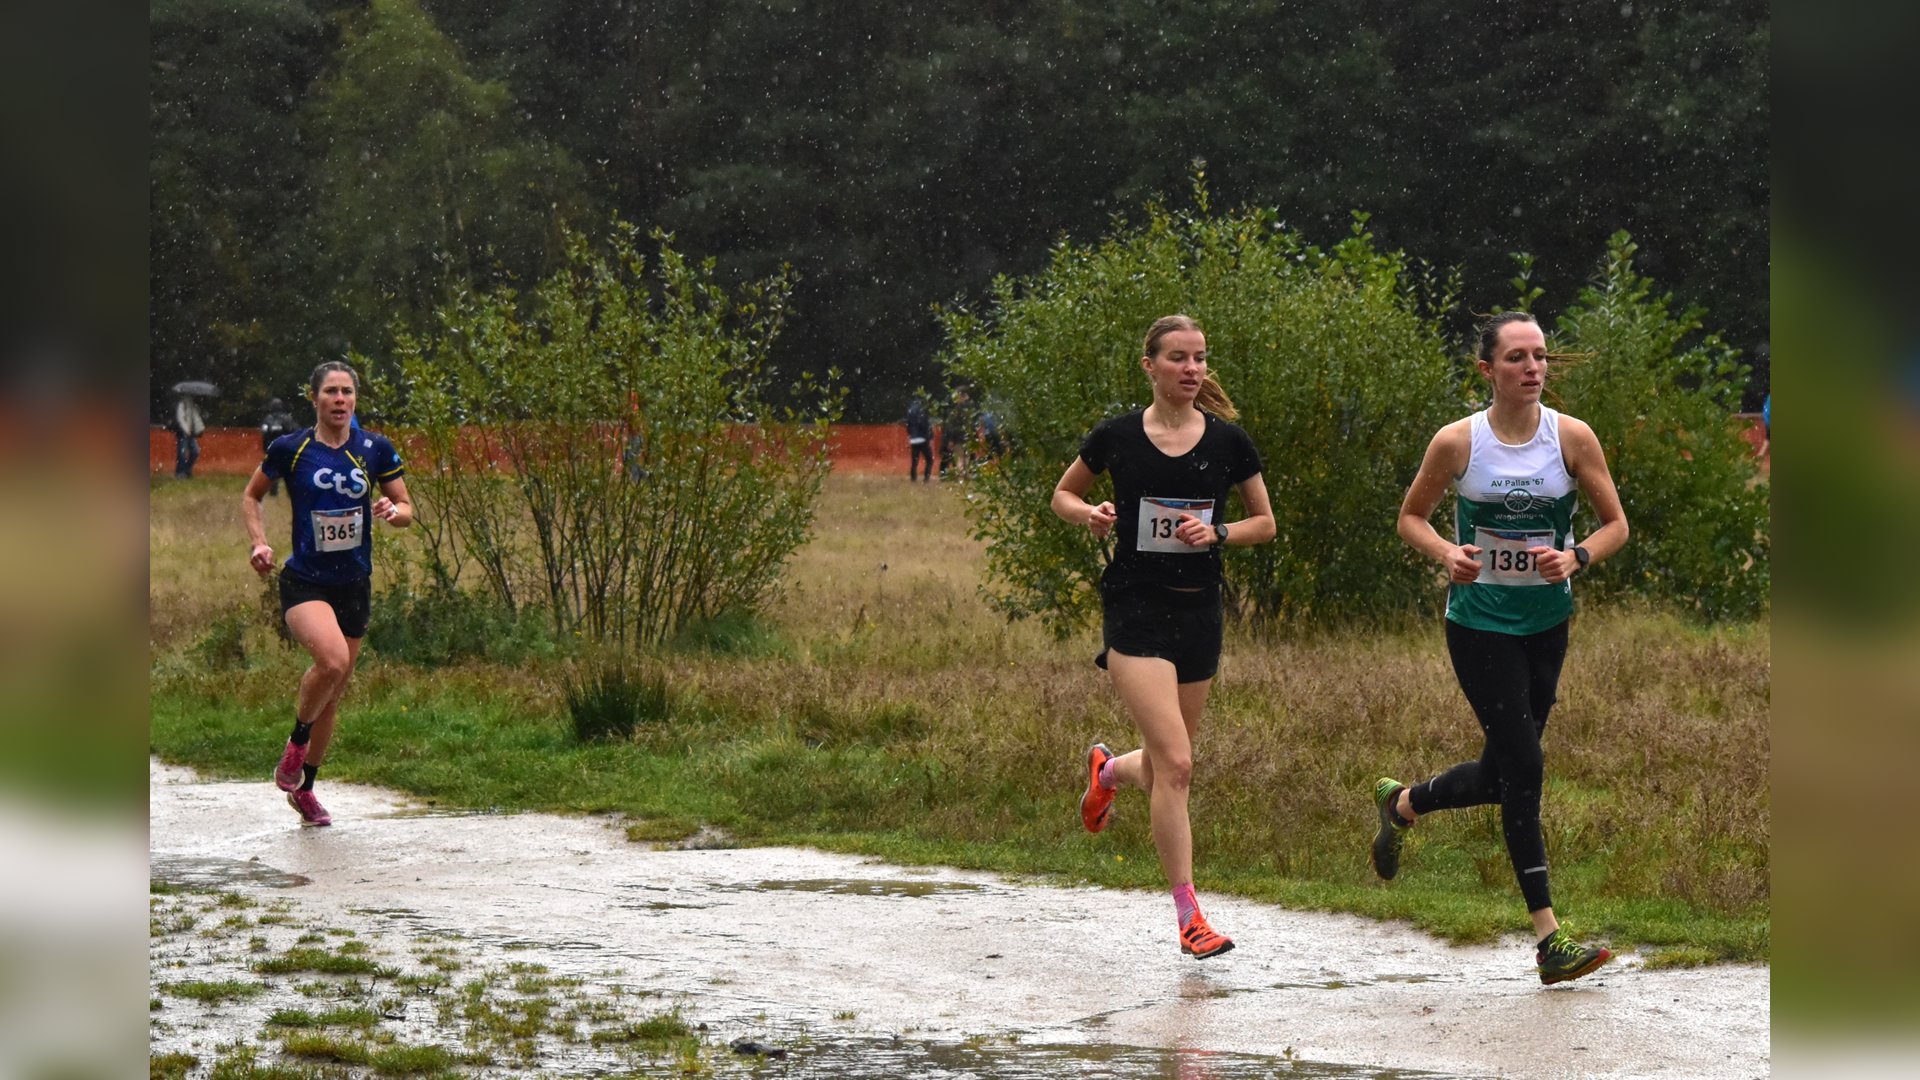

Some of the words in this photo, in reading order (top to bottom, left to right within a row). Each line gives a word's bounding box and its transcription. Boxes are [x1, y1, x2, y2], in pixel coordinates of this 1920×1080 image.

[313, 467, 368, 499] CtS
[1505, 479, 1530, 487] Pallas
[1532, 478, 1545, 486] '67
[320, 523, 356, 541] 1365
[1489, 549, 1538, 572] 1381
